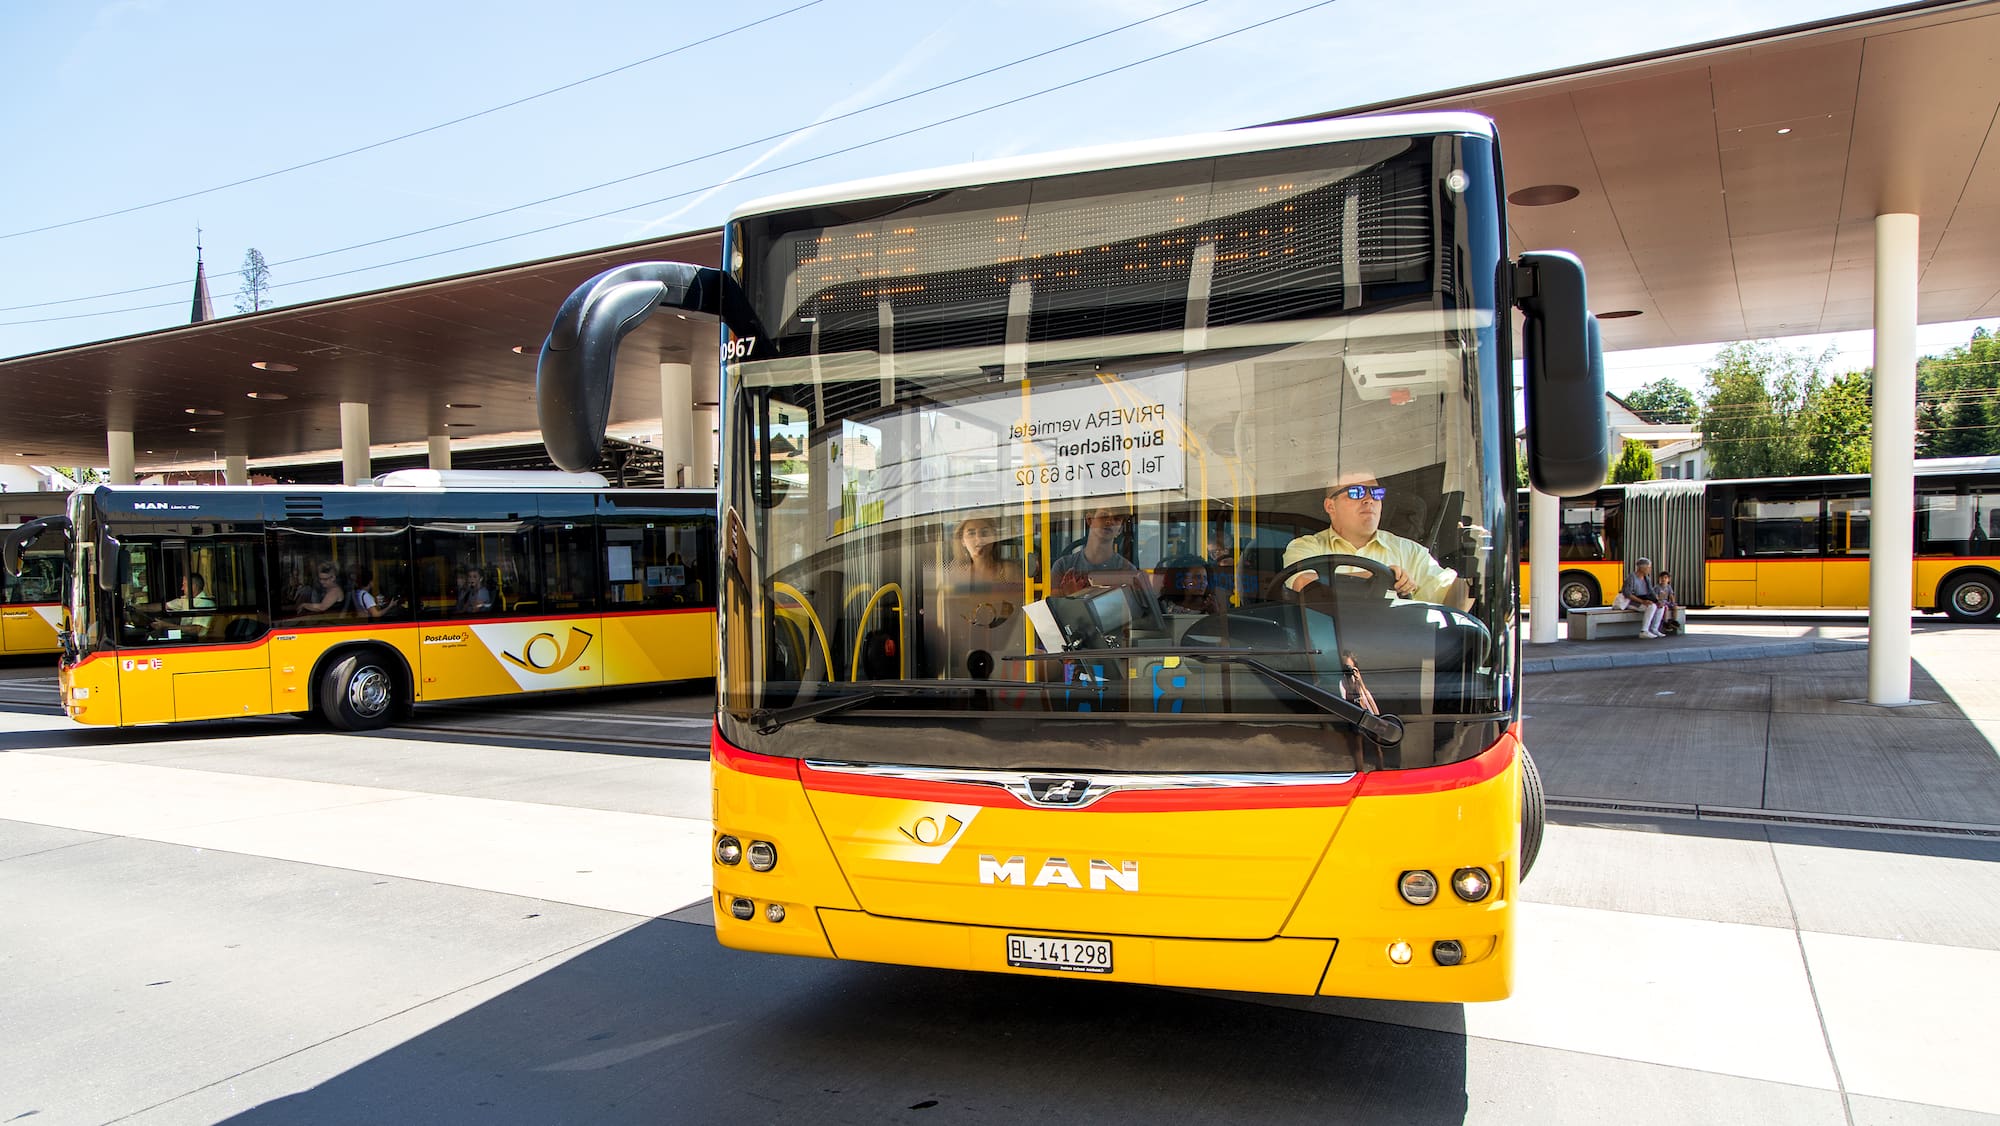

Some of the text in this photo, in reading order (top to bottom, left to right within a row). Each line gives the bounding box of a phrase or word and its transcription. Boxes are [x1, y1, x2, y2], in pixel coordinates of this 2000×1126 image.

[134, 502, 168, 510] MAN
[425, 634, 461, 642] PostAuto
[979, 854, 1139, 892] MAN
